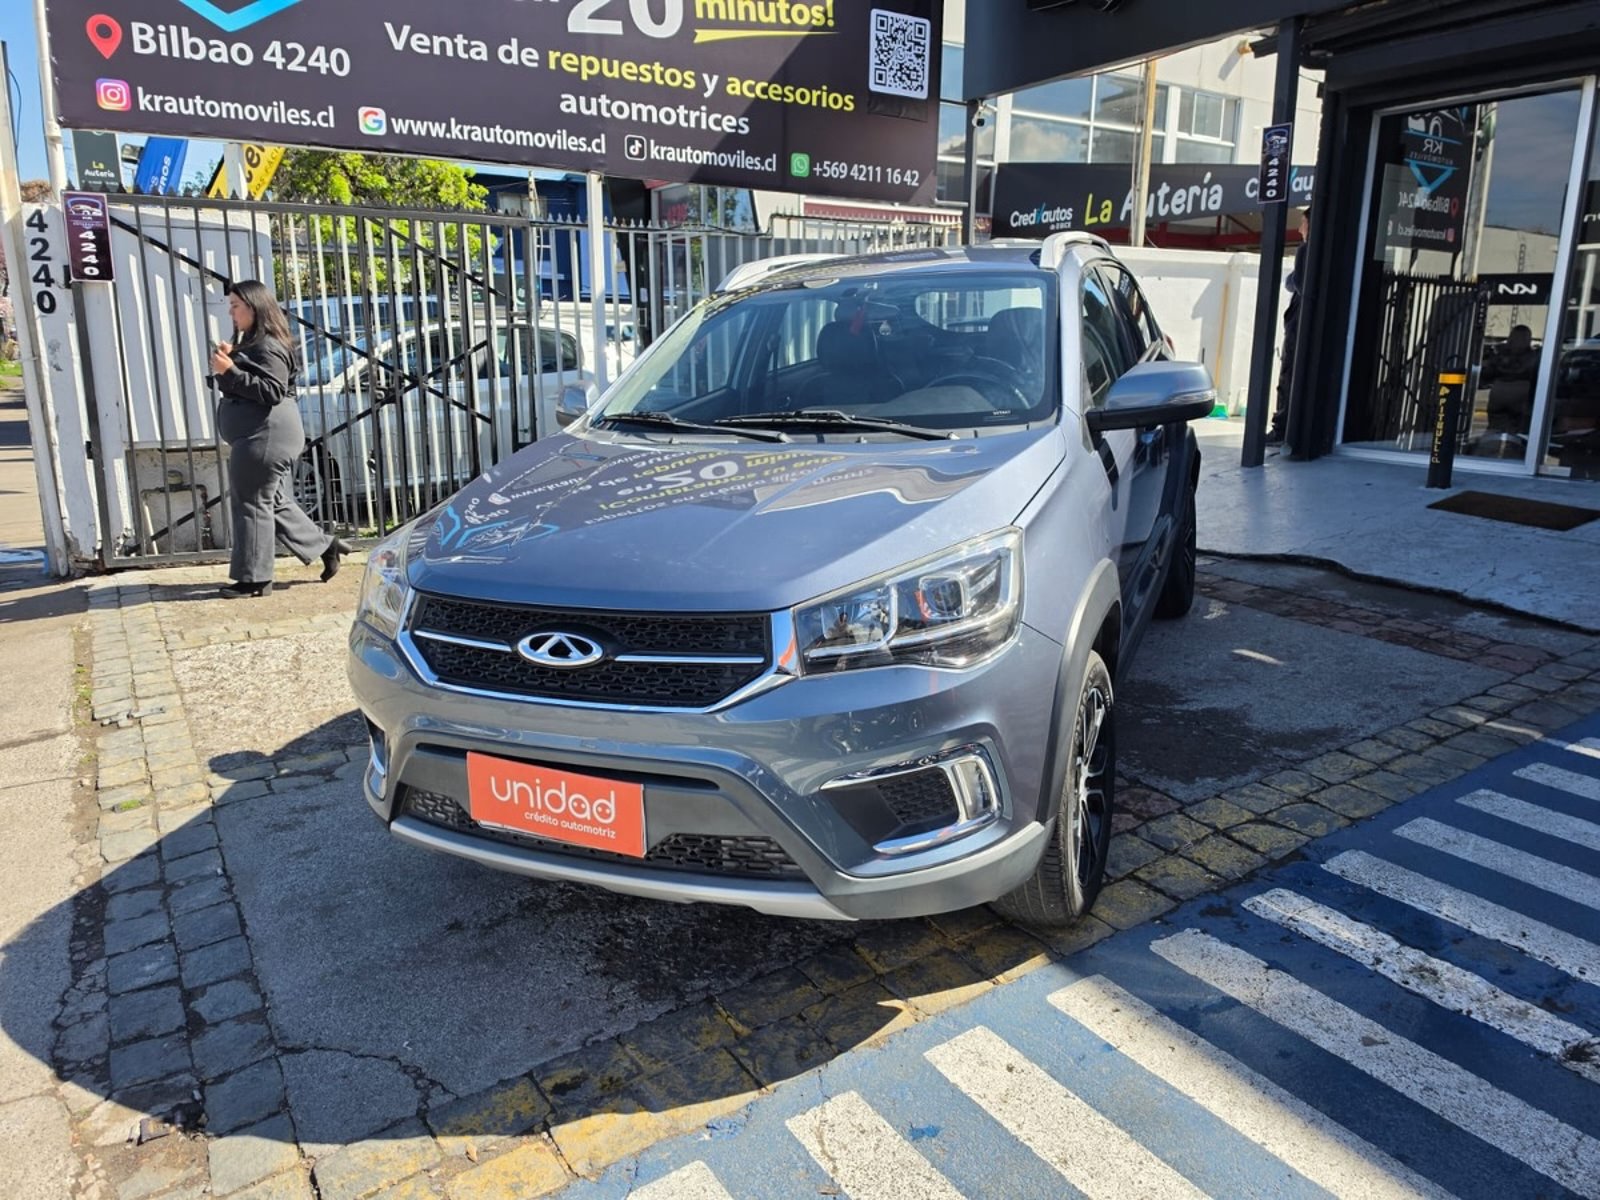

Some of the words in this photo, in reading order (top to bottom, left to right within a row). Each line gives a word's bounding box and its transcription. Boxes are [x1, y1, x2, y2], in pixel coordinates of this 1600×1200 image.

[694, 0, 835, 27] minutos!
[131, 21, 254, 67] Bilbao
[262, 41, 351, 77] 4240
[384, 22, 488, 61] Venta
[497, 38, 540, 67] de
[548, 50, 696, 89] repuestos
[702, 73, 719, 98] y
[726, 75, 855, 111] accesorios
[137, 86, 335, 129] krautomoviles.cl
[559, 93, 750, 135] automotrices
[391, 116, 607, 154] www.krautomoviles.cl
[650, 140, 776, 172] krautomoviles.cl
[813, 161, 848, 179] +569
[850, 164, 881, 182] 4211
[886, 168, 901, 185] 16
[903, 170, 920, 186] 42
[1266, 158, 1279, 197] 4240
[1085, 193, 1112, 225] La
[26, 209, 56, 314] 4240
[79, 230, 99, 276] 4240
[490, 775, 616, 824] unidad
[524, 812, 558, 827] crédito
[561, 818, 616, 839] automotriz
